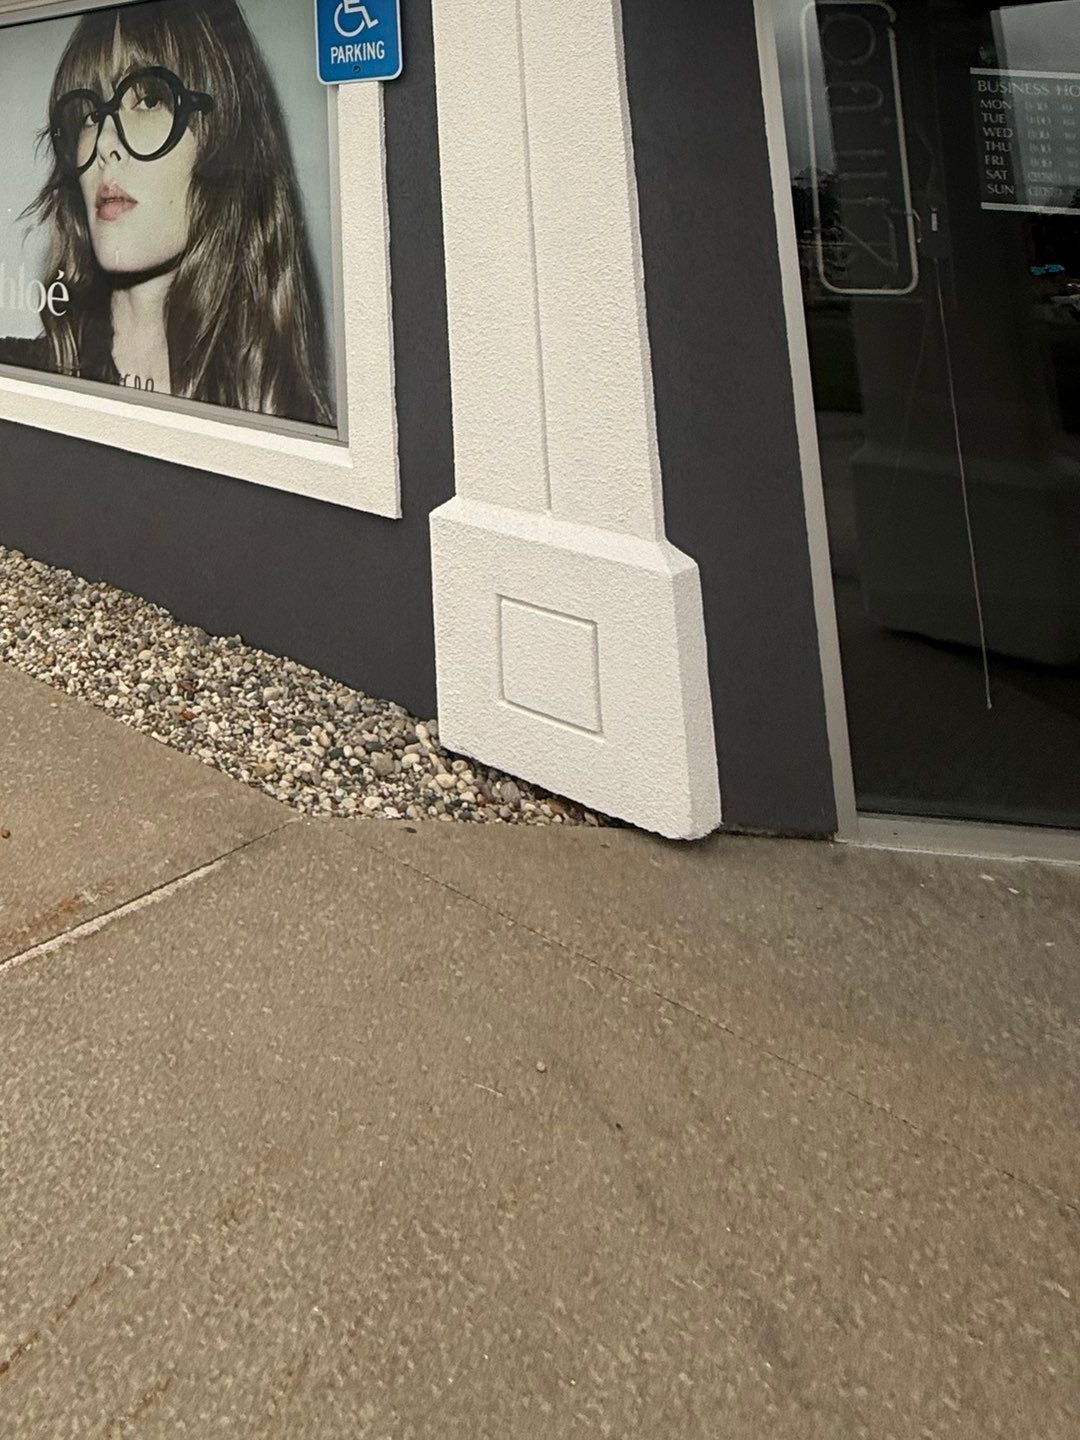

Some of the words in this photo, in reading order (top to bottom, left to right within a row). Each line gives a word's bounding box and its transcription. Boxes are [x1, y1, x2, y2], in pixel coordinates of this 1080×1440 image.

[330, 40, 386, 65] PARKING
[977, 80, 1050, 96] BUSINESS
[980, 99, 1012, 109] MON
[981, 112, 1006, 123] TUE
[982, 127, 1014, 138] WED
[985, 141, 1012, 152] THU
[984, 155, 1004, 165] FRI
[985, 170, 1008, 180] SAT
[986, 183, 1015, 194] SUN
